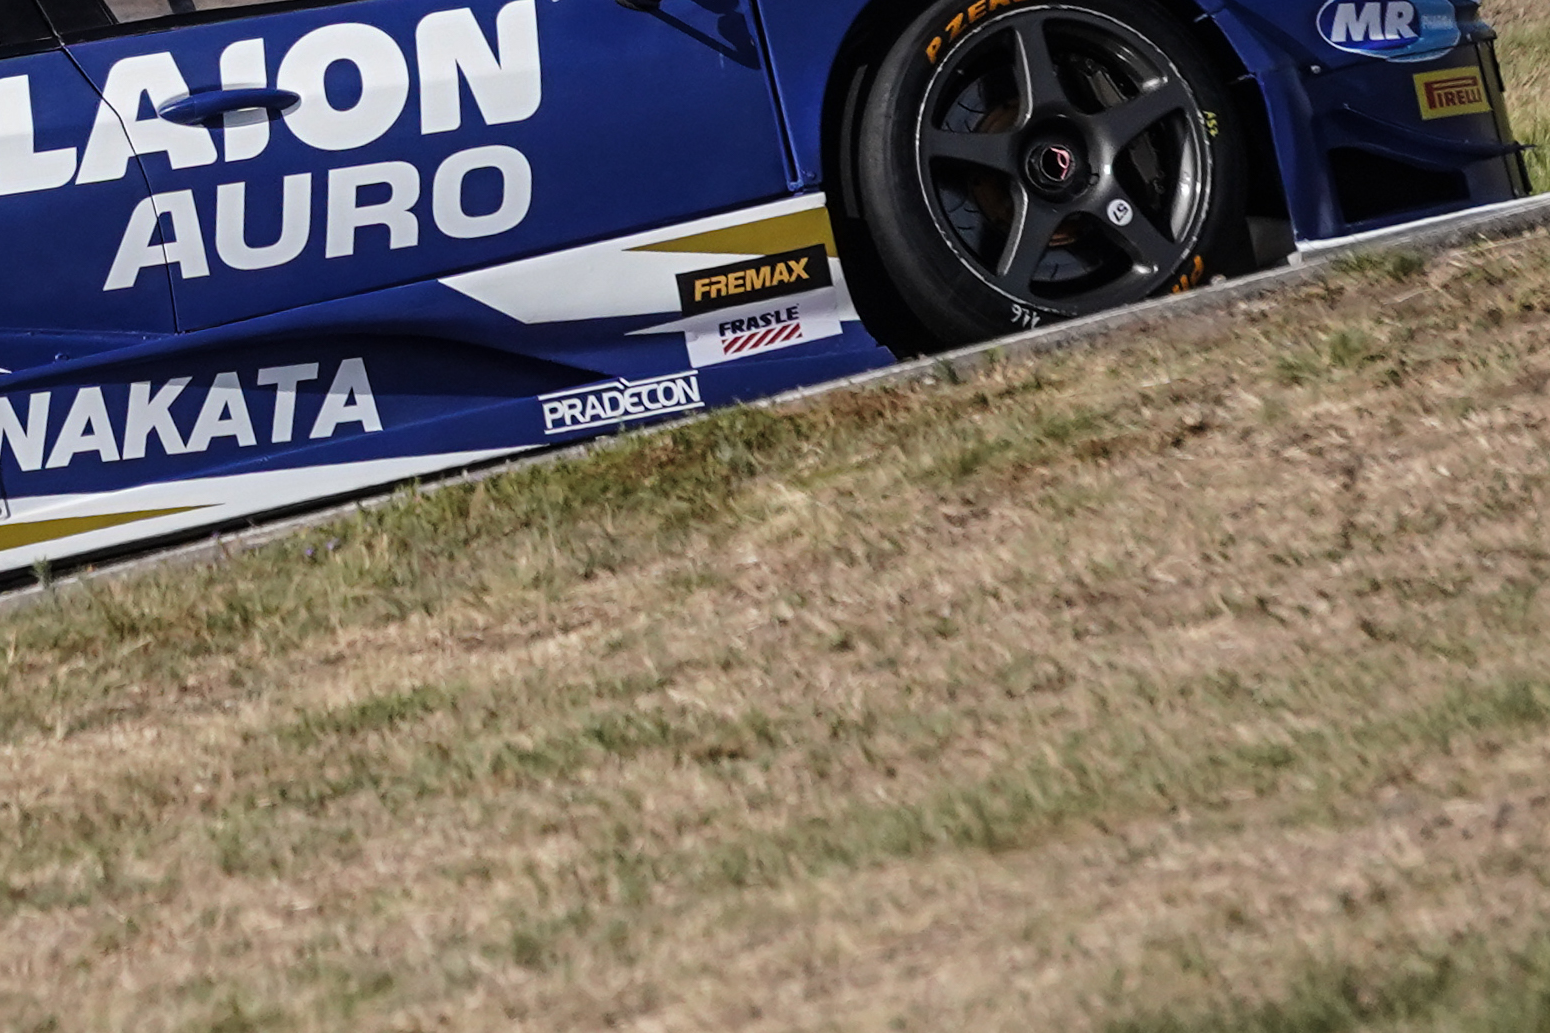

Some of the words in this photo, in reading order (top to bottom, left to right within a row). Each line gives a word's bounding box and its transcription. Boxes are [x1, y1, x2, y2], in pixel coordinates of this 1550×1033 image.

[1331, 1, 1418, 42] MR
[925, 36, 942, 64] P
[1424, 75, 1482, 110] PIRELLI
[103, 145, 532, 291] AURO
[1112, 203, 1129, 222] 57
[694, 257, 810, 302] FREMAX
[542, 374, 701, 429] PRADECON
